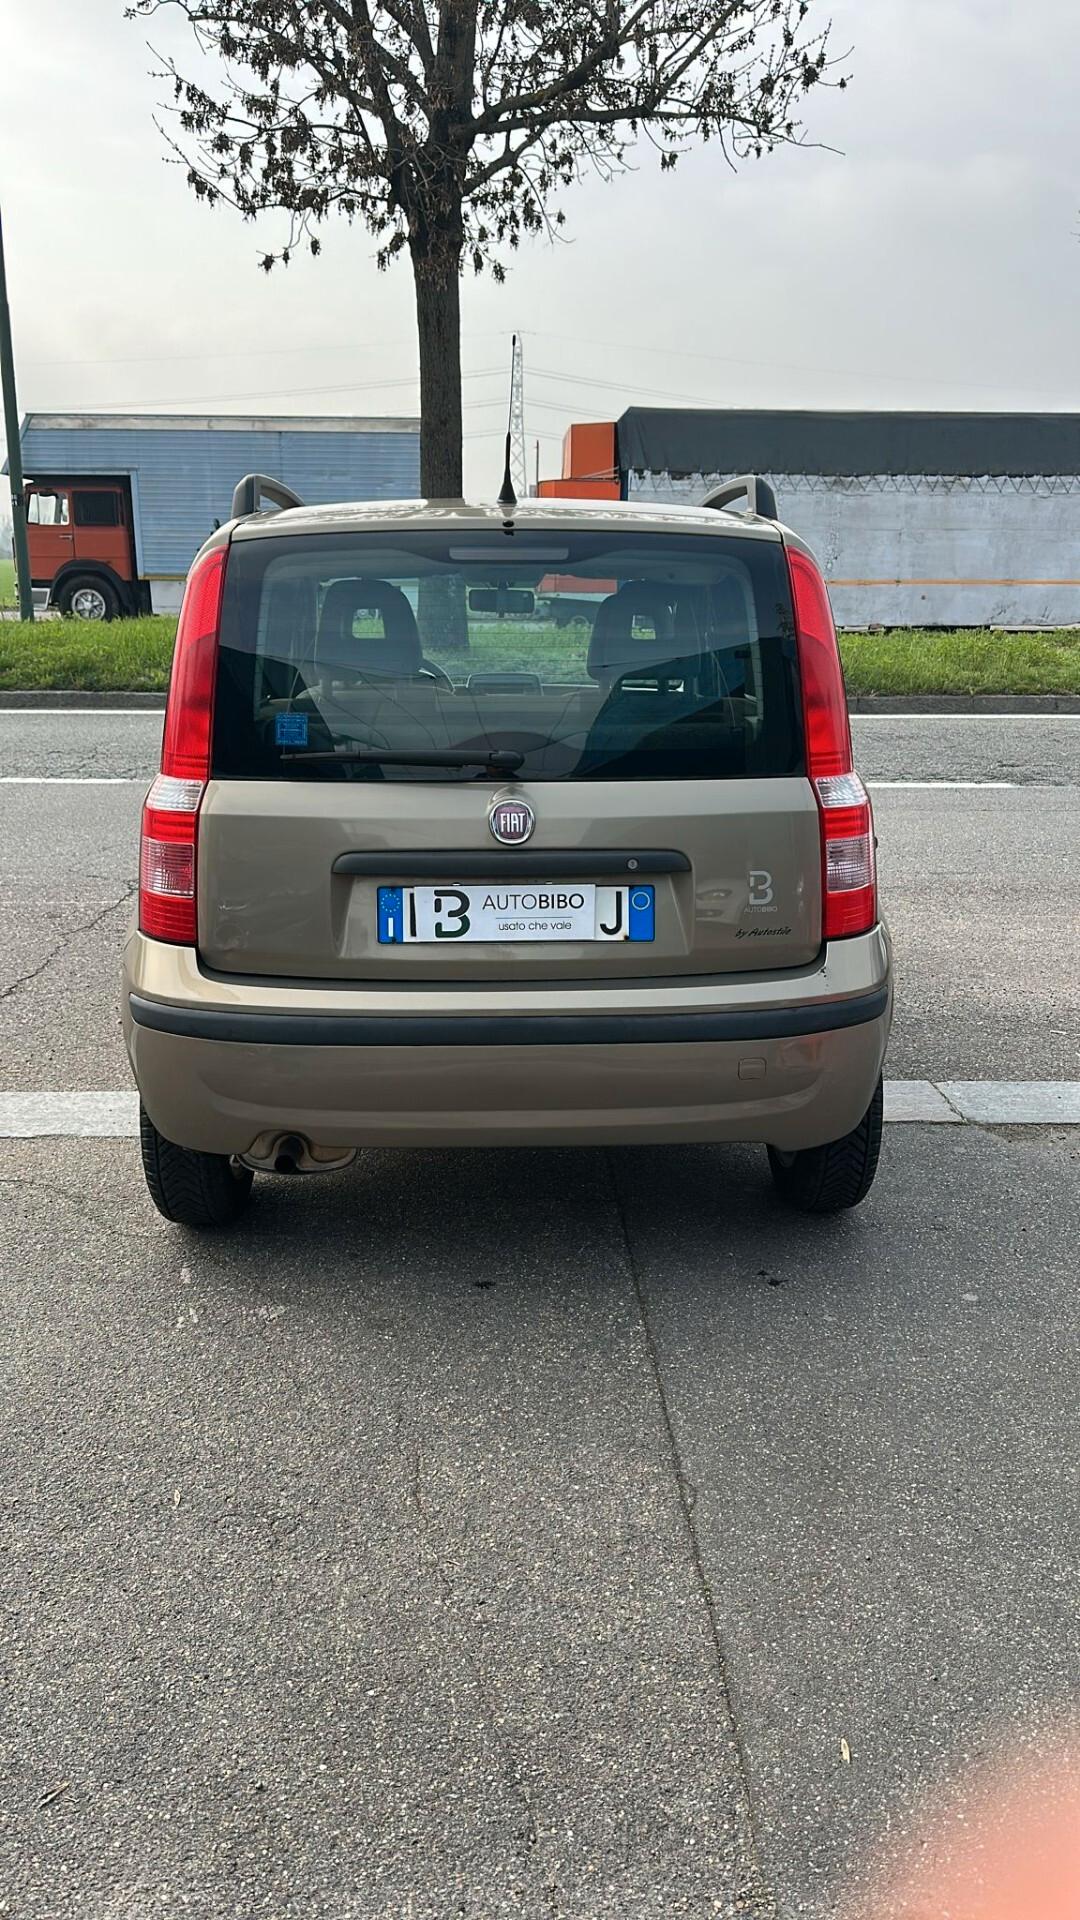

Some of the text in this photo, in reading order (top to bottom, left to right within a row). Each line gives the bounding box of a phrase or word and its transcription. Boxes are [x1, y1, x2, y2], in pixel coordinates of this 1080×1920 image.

[500, 813, 526, 832] FIAT
[482, 893, 585, 910] AUTOBIBO
[434, 889, 470, 938] B
[599, 891, 623, 935] J
[498, 920, 572, 931] usato che vale
